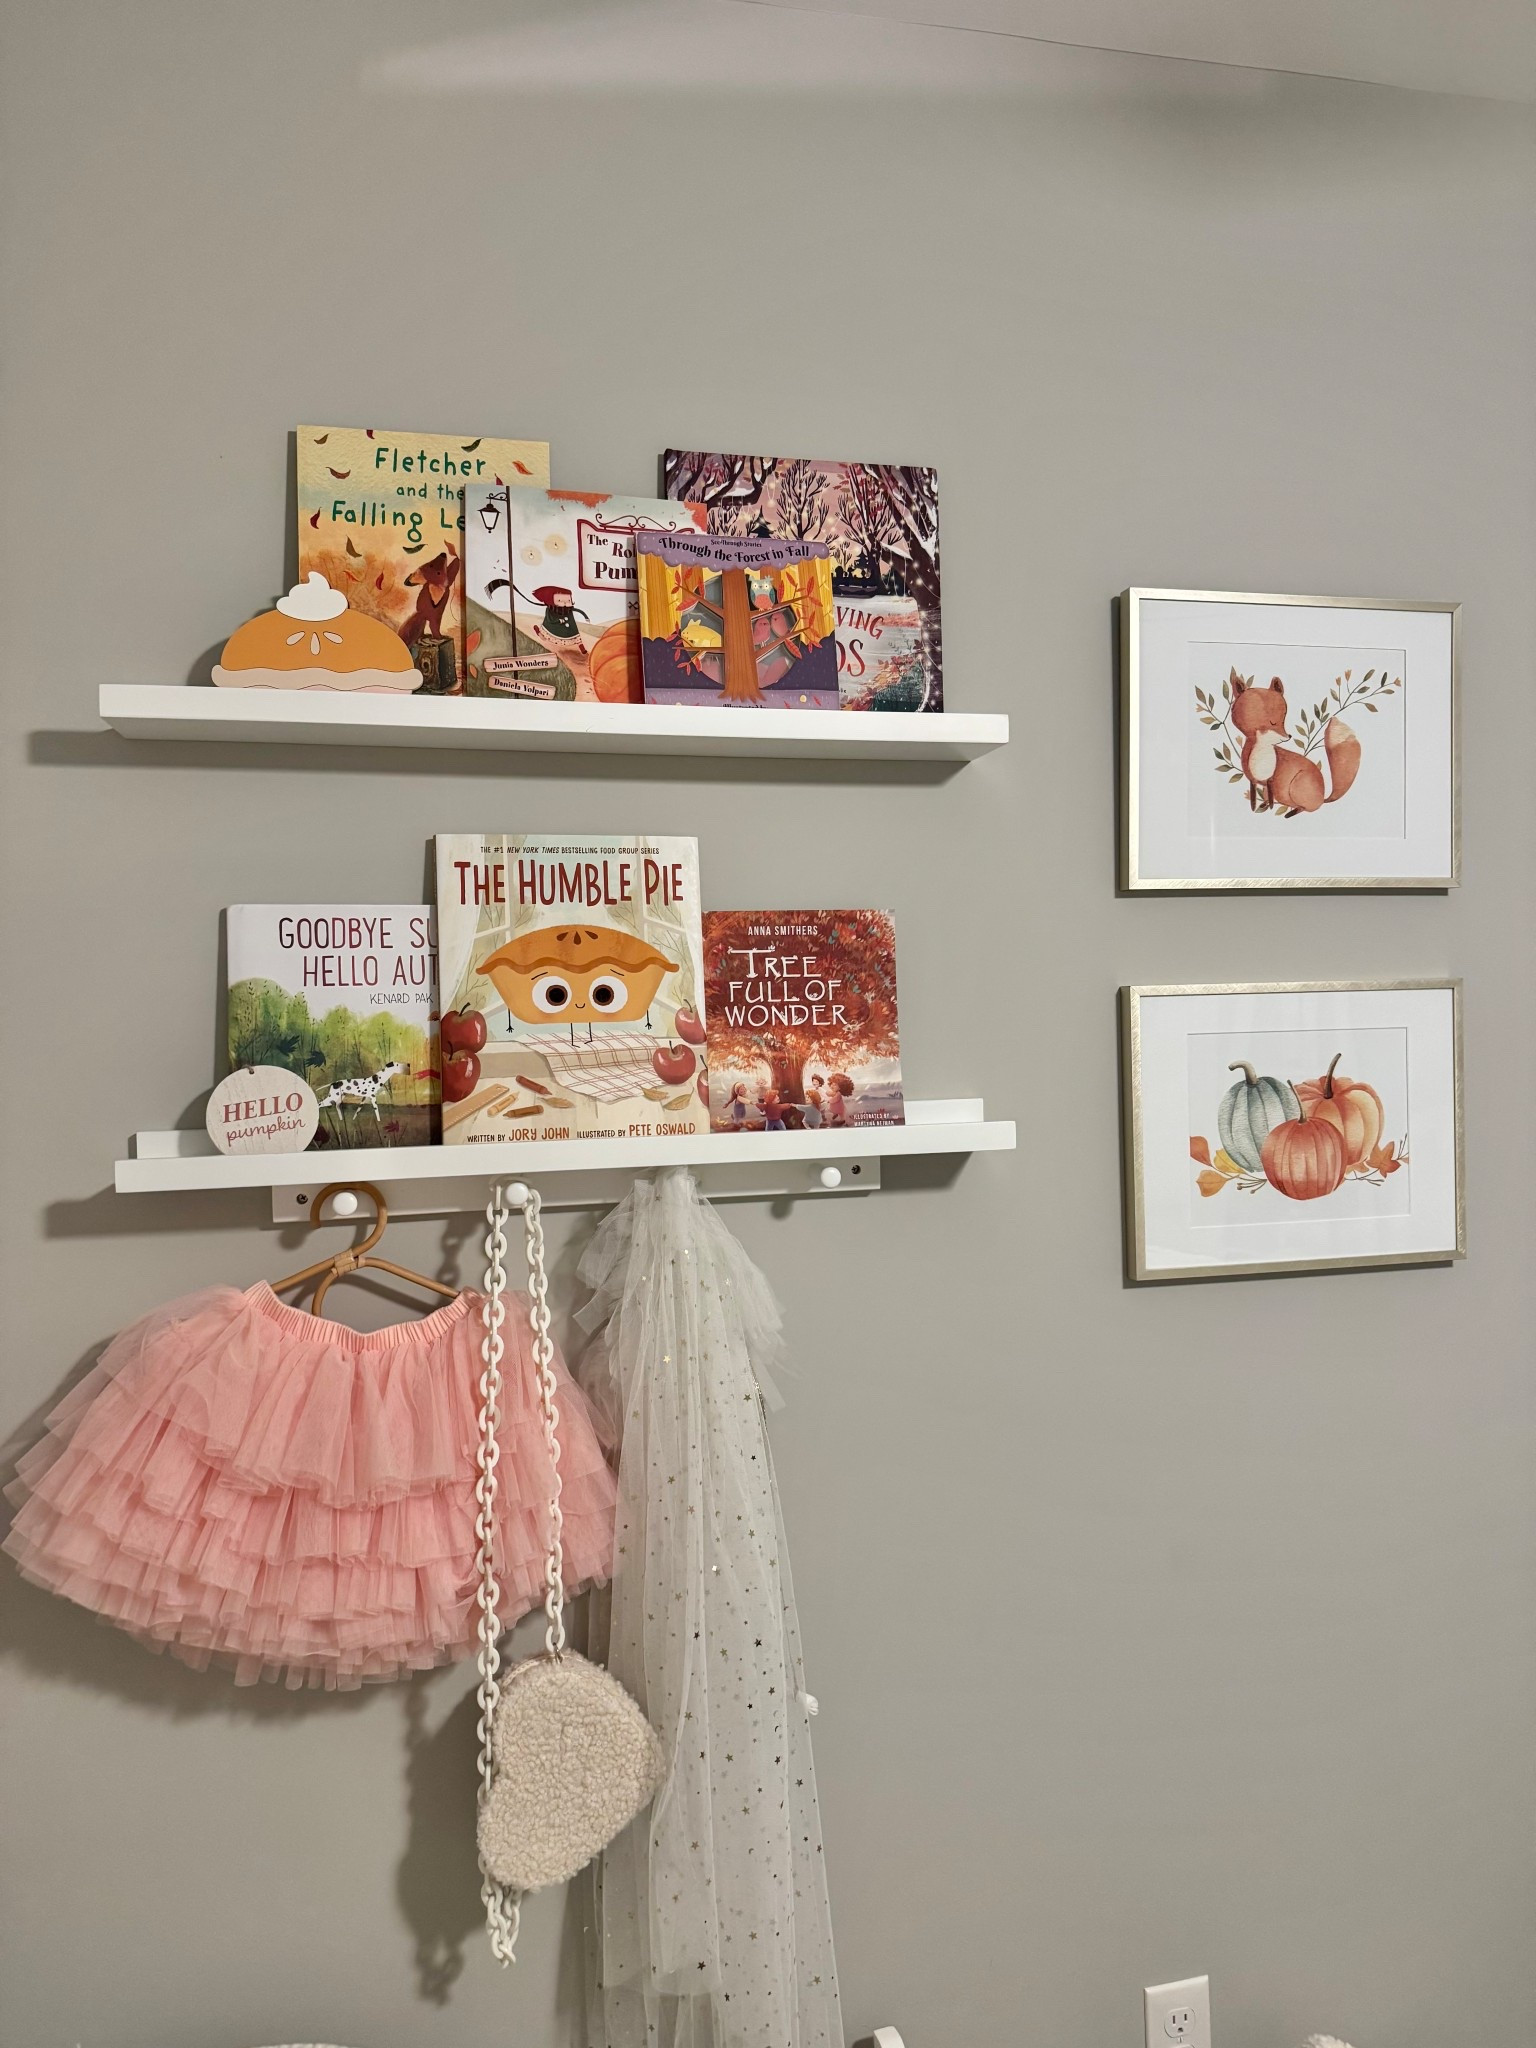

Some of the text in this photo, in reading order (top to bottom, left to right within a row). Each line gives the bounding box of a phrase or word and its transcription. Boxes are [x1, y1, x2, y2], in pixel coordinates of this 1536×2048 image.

[375, 447, 486, 477] Fletcher
[396, 484, 465, 501] and the
[331, 500, 423, 543] Falling
[587, 534, 608, 546] The
[658, 537, 810, 563] Through the Forest in Fall
[493, 659, 549, 671] Junia Wonders
[494, 678, 549, 697] Daniela Volpari
[494, 846, 504, 854] #1
[506, 846, 520, 854] NEW
[522, 846, 539, 854] YORK
[541, 846, 559, 854] TIMES
[600, 847, 616, 855] FOOD
[618, 847, 639, 855] GROUP
[640, 847, 660, 855] SERIES
[454, 861, 506, 906] THE
[518, 859, 632, 907] HUMBLE
[644, 858, 684, 906] PIE
[279, 917, 394, 949] GOODBYE
[748, 925, 818, 936] ANNA SMITHERS
[303, 955, 378, 987] HELLO
[727, 944, 822, 980] TREE
[370, 993, 434, 1005] KENARD PAK
[728, 979, 842, 1004] FULL OF
[724, 1004, 848, 1027] WONDER
[222, 1092, 303, 1124] HELLO
[226, 1115, 306, 1147] pumpkin
[467, 1122, 696, 1143] WRITTEN BY JORY JOHN ILLUSTRATED BY PETE OSWALD
